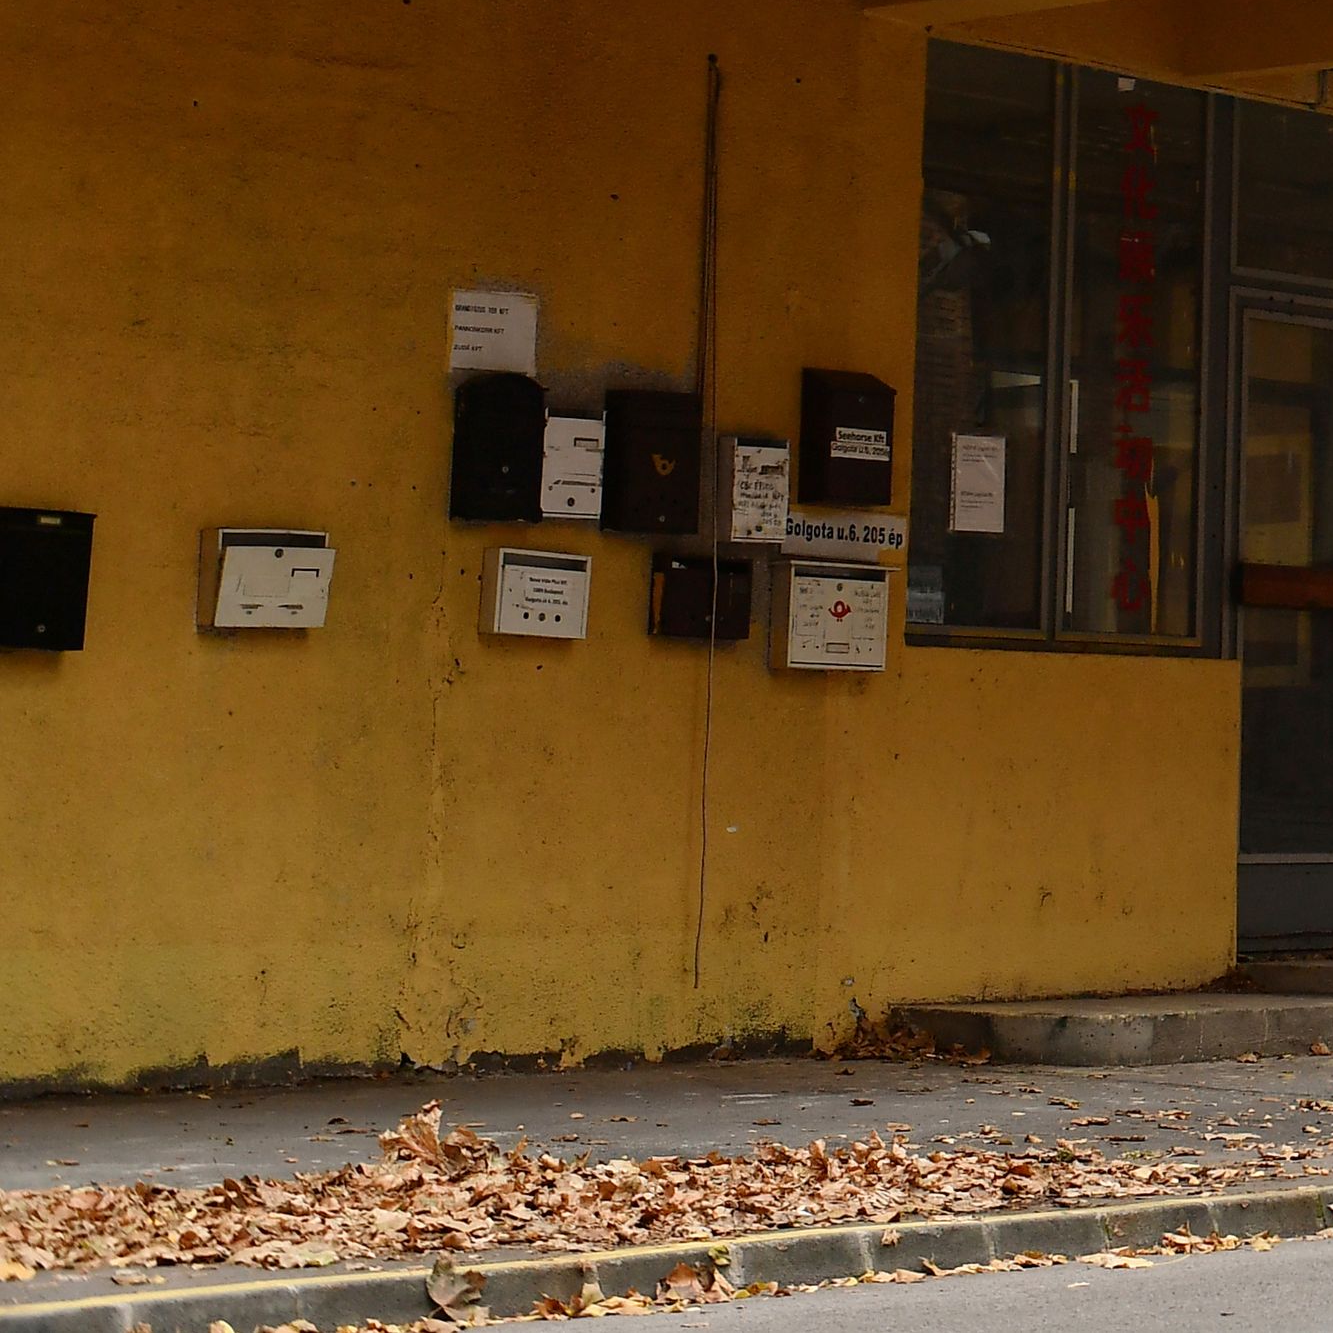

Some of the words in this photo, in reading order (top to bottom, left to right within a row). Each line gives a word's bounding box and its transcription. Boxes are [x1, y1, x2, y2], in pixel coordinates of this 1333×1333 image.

[786, 518, 833, 541] Golgota
[837, 524, 859, 541] u.6.
[863, 525, 885, 544] 205
[888, 528, 903, 549] ép
